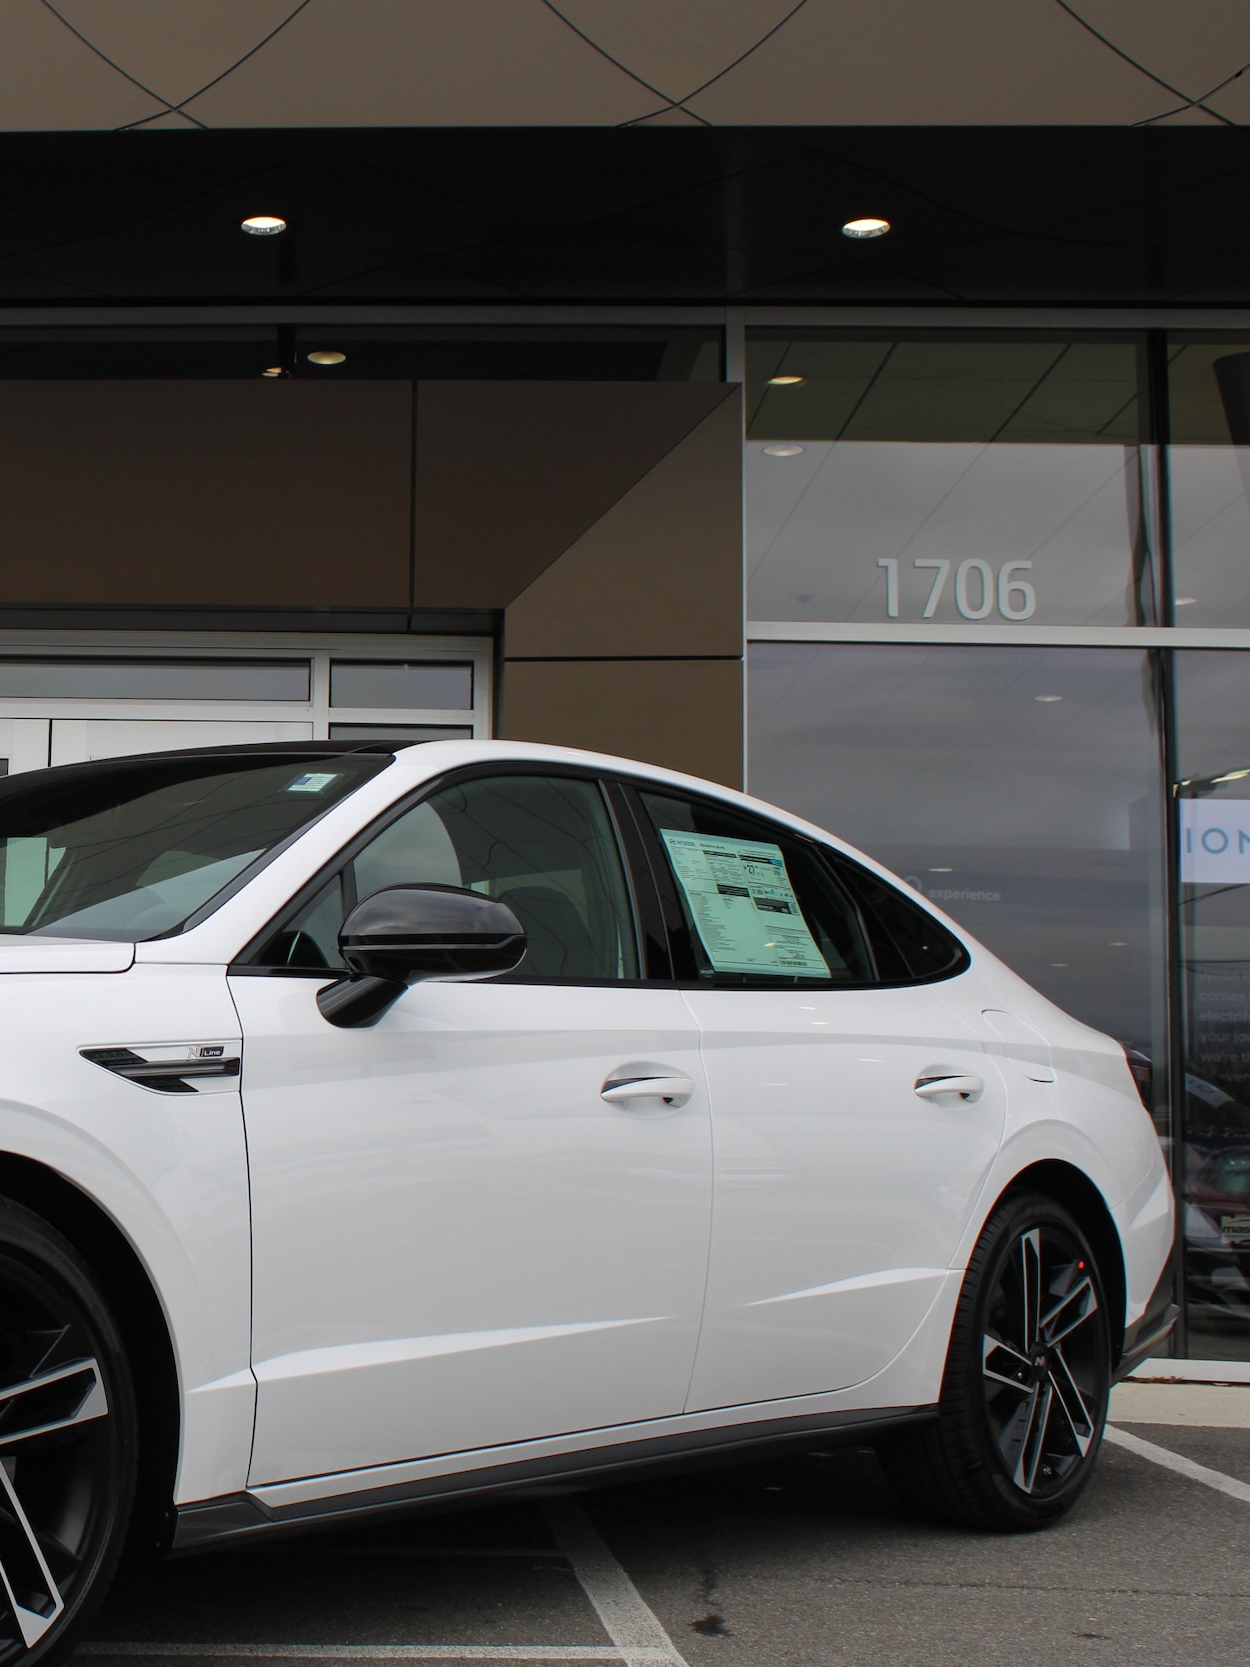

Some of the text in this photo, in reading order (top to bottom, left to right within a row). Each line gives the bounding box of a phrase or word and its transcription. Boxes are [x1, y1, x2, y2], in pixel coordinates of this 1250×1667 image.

[877, 557, 1037, 621] 1706
[928, 887, 1001, 902] experience
[1199, 991, 1246, 1002] comes
[1199, 1009, 1250, 1022] electrif
[1200, 1032, 1230, 1044] your
[187, 1047, 221, 1059] N Line
